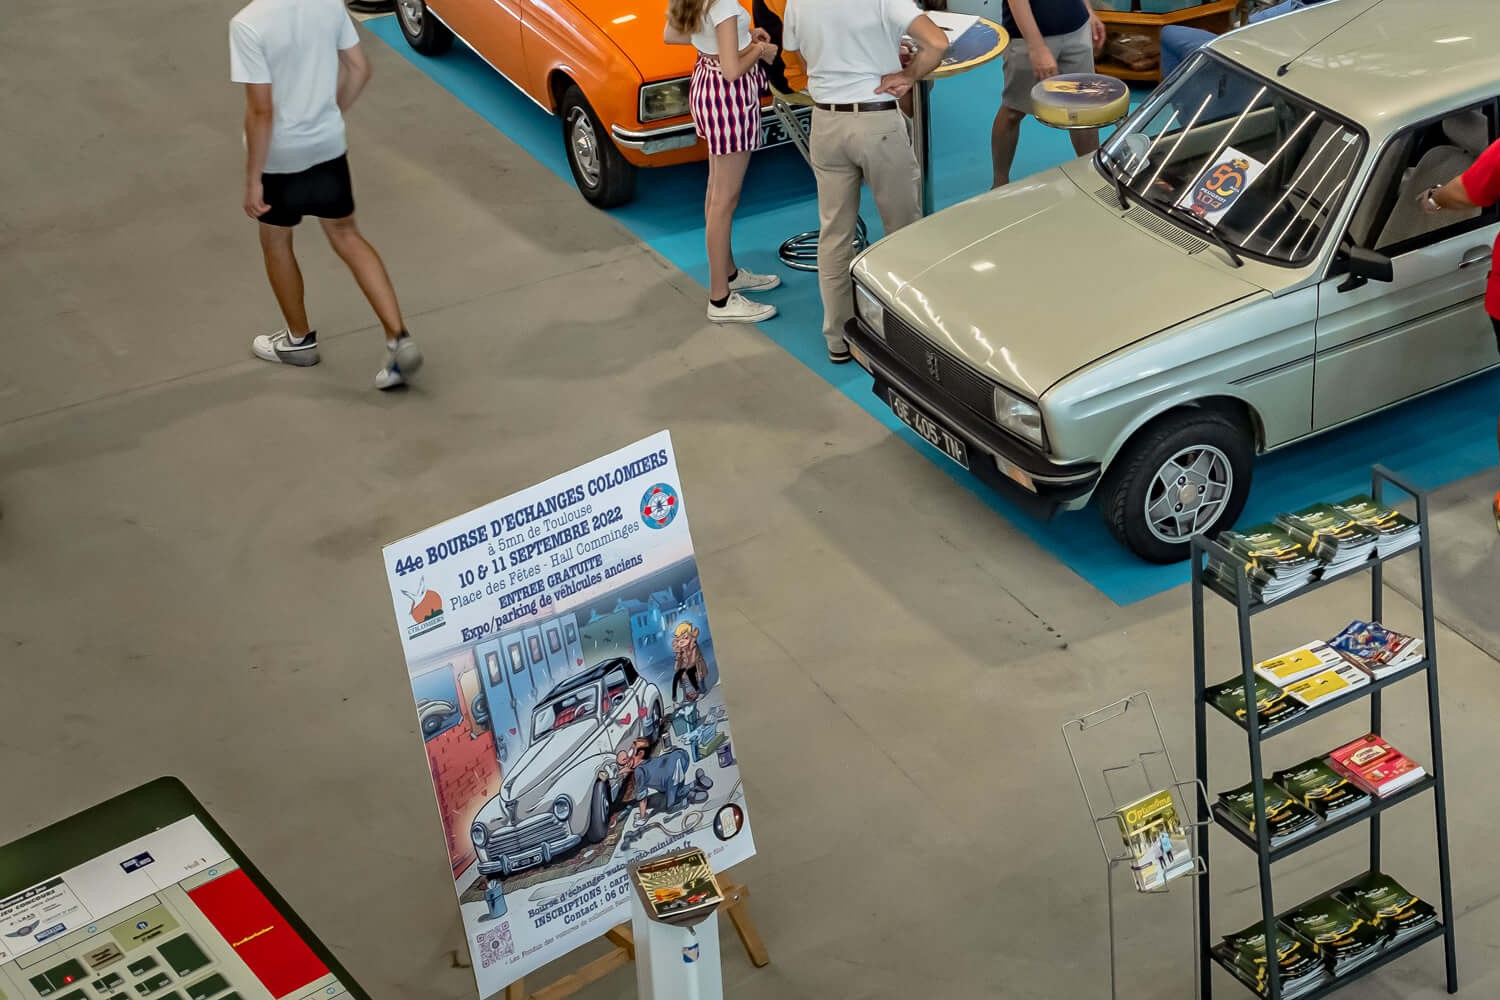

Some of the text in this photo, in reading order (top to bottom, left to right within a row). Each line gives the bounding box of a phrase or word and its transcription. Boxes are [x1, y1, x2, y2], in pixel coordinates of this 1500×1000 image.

[1205, 163, 1243, 197] 50
[395, 449, 669, 577] 44e BOURSE D'ECHANGES COLOMIERS
[488, 502, 594, 557] à 5mn de Toulouse
[450, 589, 484, 612] Place
[485, 576, 507, 596] des
[508, 562, 542, 586] Fêtes
[549, 547, 575, 570] Hall
[575, 518, 641, 559] Comminges
[457, 505, 624, 589] 10 & 11 SEPTEMBRE 2022
[460, 552, 644, 643] Expo/parking de véhicules anciens
[498, 553, 604, 610] ENTREE GRATUITE
[407, 615, 446, 634] COLOMIERS
[527, 897, 561, 919] Bourse
[559, 872, 606, 903] d'échanges
[534, 885, 602, 929] INSCRIPTIONS
[563, 900, 598, 925] Contact
[604, 890, 617, 902] 06
[617, 882, 631, 895] 07
